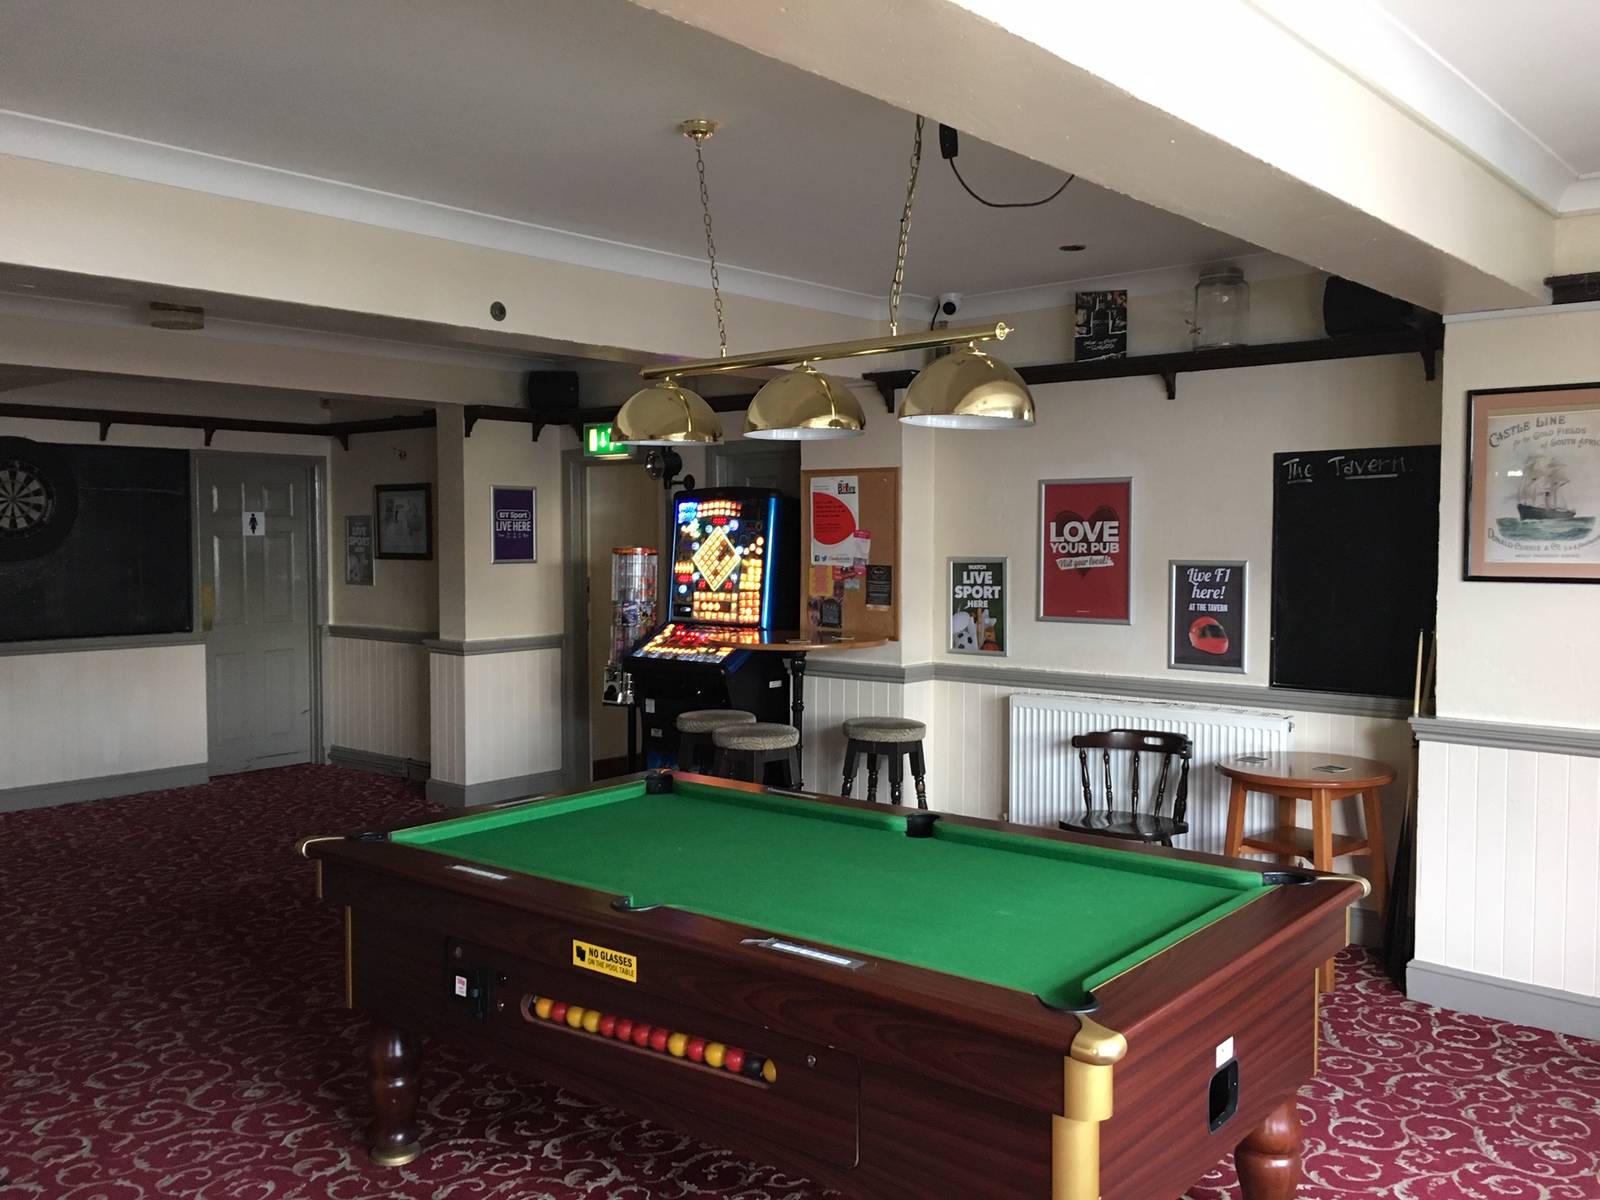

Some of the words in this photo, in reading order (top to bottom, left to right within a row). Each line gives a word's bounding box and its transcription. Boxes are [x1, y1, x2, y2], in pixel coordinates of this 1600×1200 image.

[1489, 421, 1530, 448] CASTLE
[1536, 415, 1567, 428] LINE
[1283, 457, 1314, 480] The
[510, 511, 528, 519] Sport
[496, 521, 512, 532] LIVE
[512, 521, 531, 532] HERE
[1050, 521, 1120, 543] LOVE
[1050, 542, 1088, 554] YOUR
[1090, 542, 1120, 554] PUB
[962, 571, 993, 584] LIVE
[1187, 567, 1212, 586] Live
[1214, 567, 1231, 583] F1
[954, 585, 1001, 599] SPORT
[1191, 586, 1226, 599] here!
[967, 599, 989, 608] HERE
[1188, 603, 1196, 611] AT
[1196, 603, 1207, 612] THE
[1208, 603, 1228, 612] TAVERN
[588, 947, 599, 958] NO
[600, 951, 633, 968] GLASSES
[605, 962, 618, 973] POOL
[619, 967, 635, 978] TABLE
